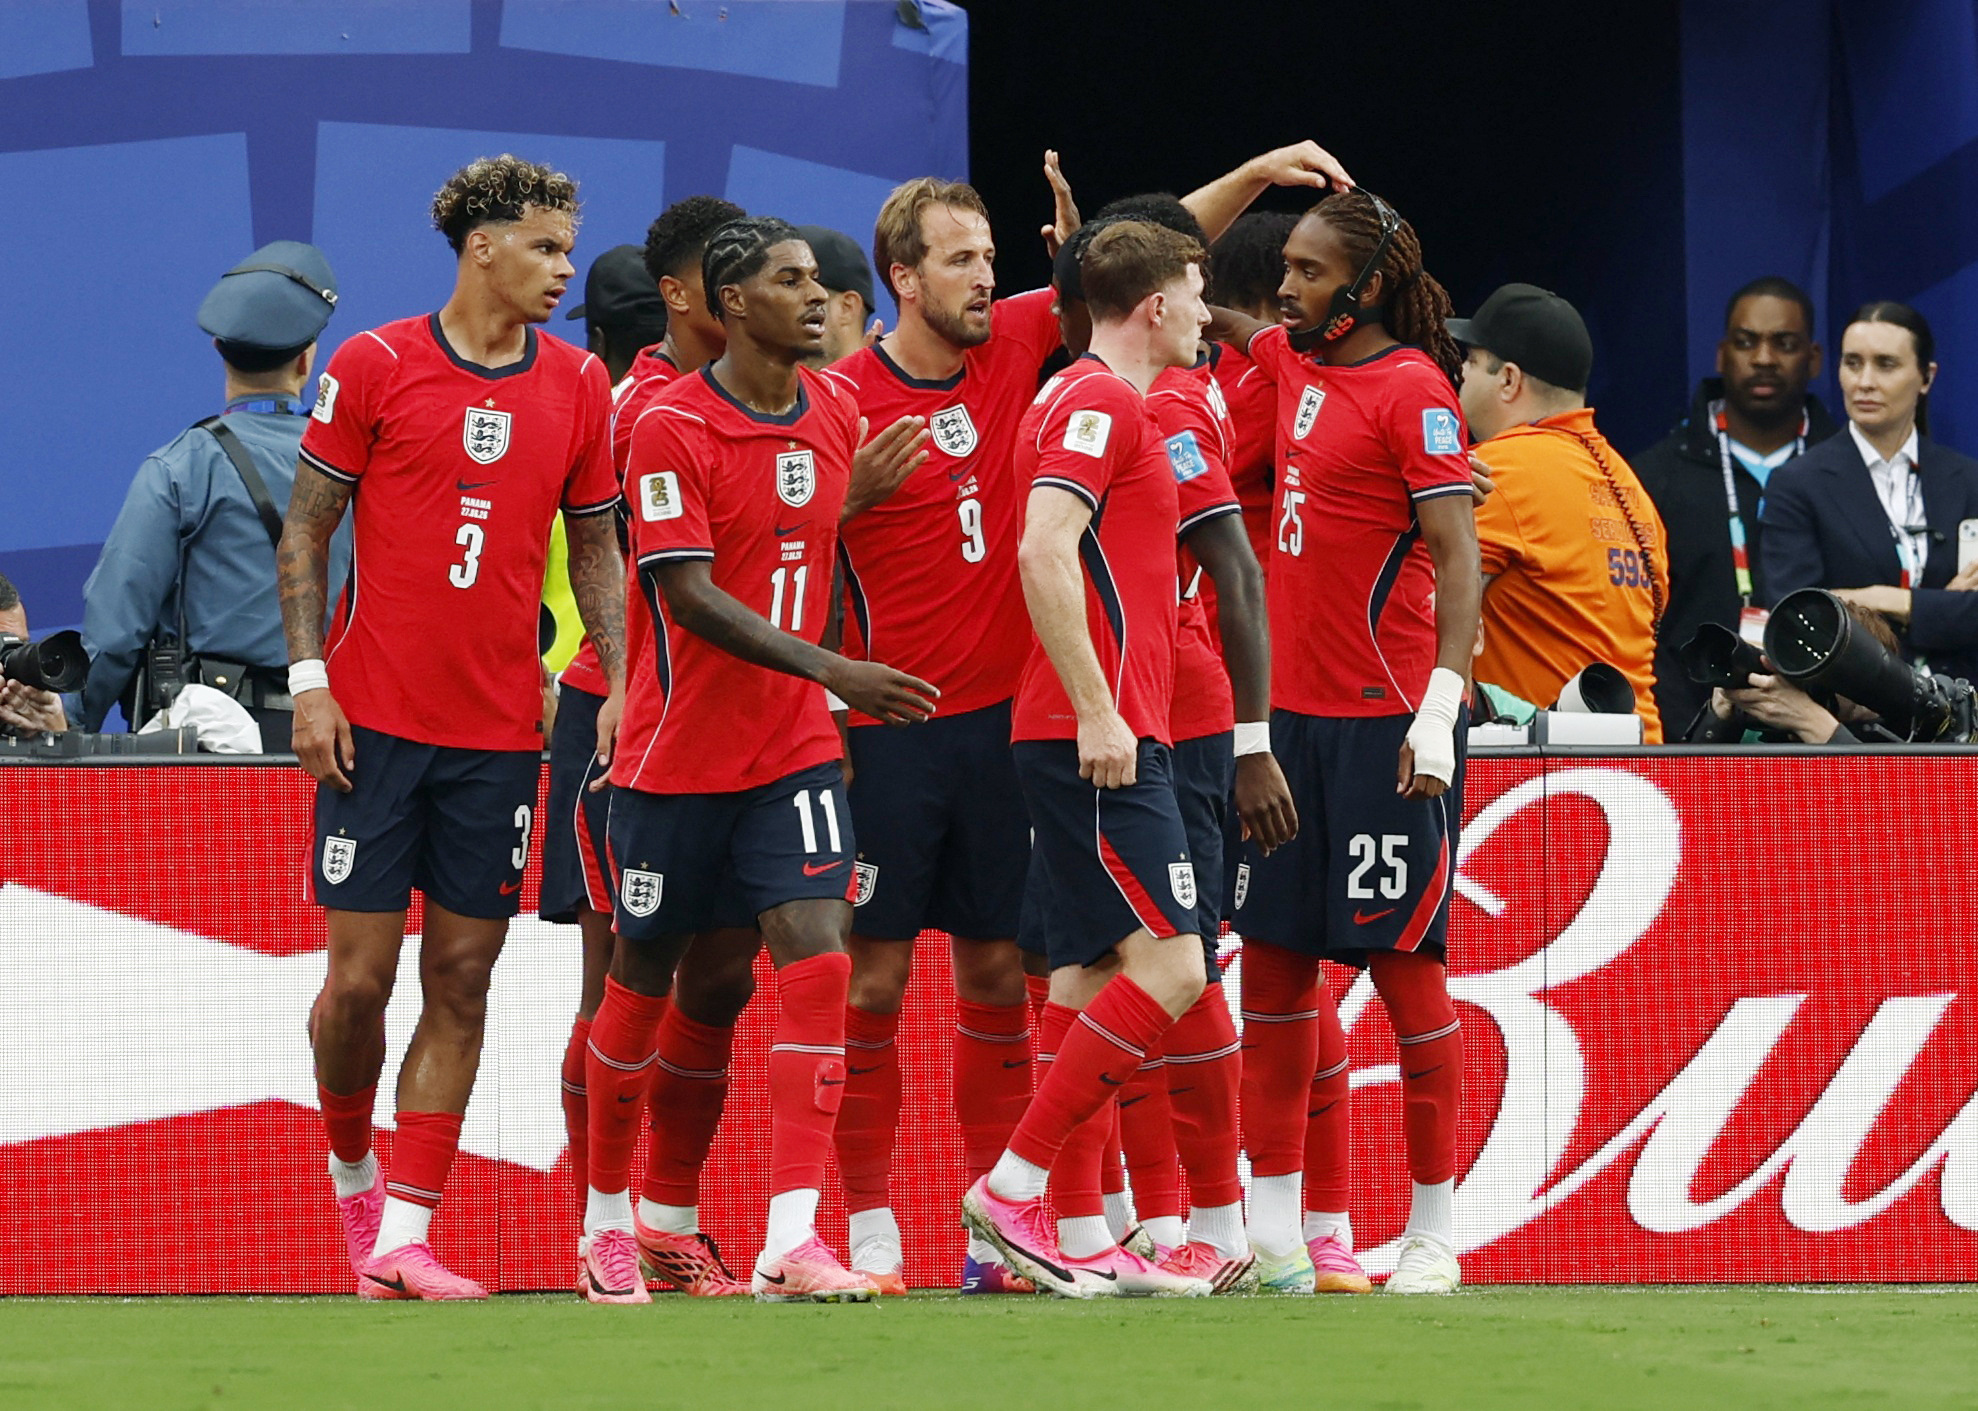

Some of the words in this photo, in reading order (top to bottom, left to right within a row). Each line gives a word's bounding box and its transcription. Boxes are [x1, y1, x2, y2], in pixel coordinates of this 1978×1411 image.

[460, 496, 492, 510] PANAMA
[957, 498, 986, 563] 9
[448, 522, 485, 590] 3
[780, 540, 805, 551] PANAMA
[770, 565, 808, 632] 11
[511, 804, 532, 870] 3
[793, 789, 842, 853] 11
[1347, 833, 1409, 900] 25
